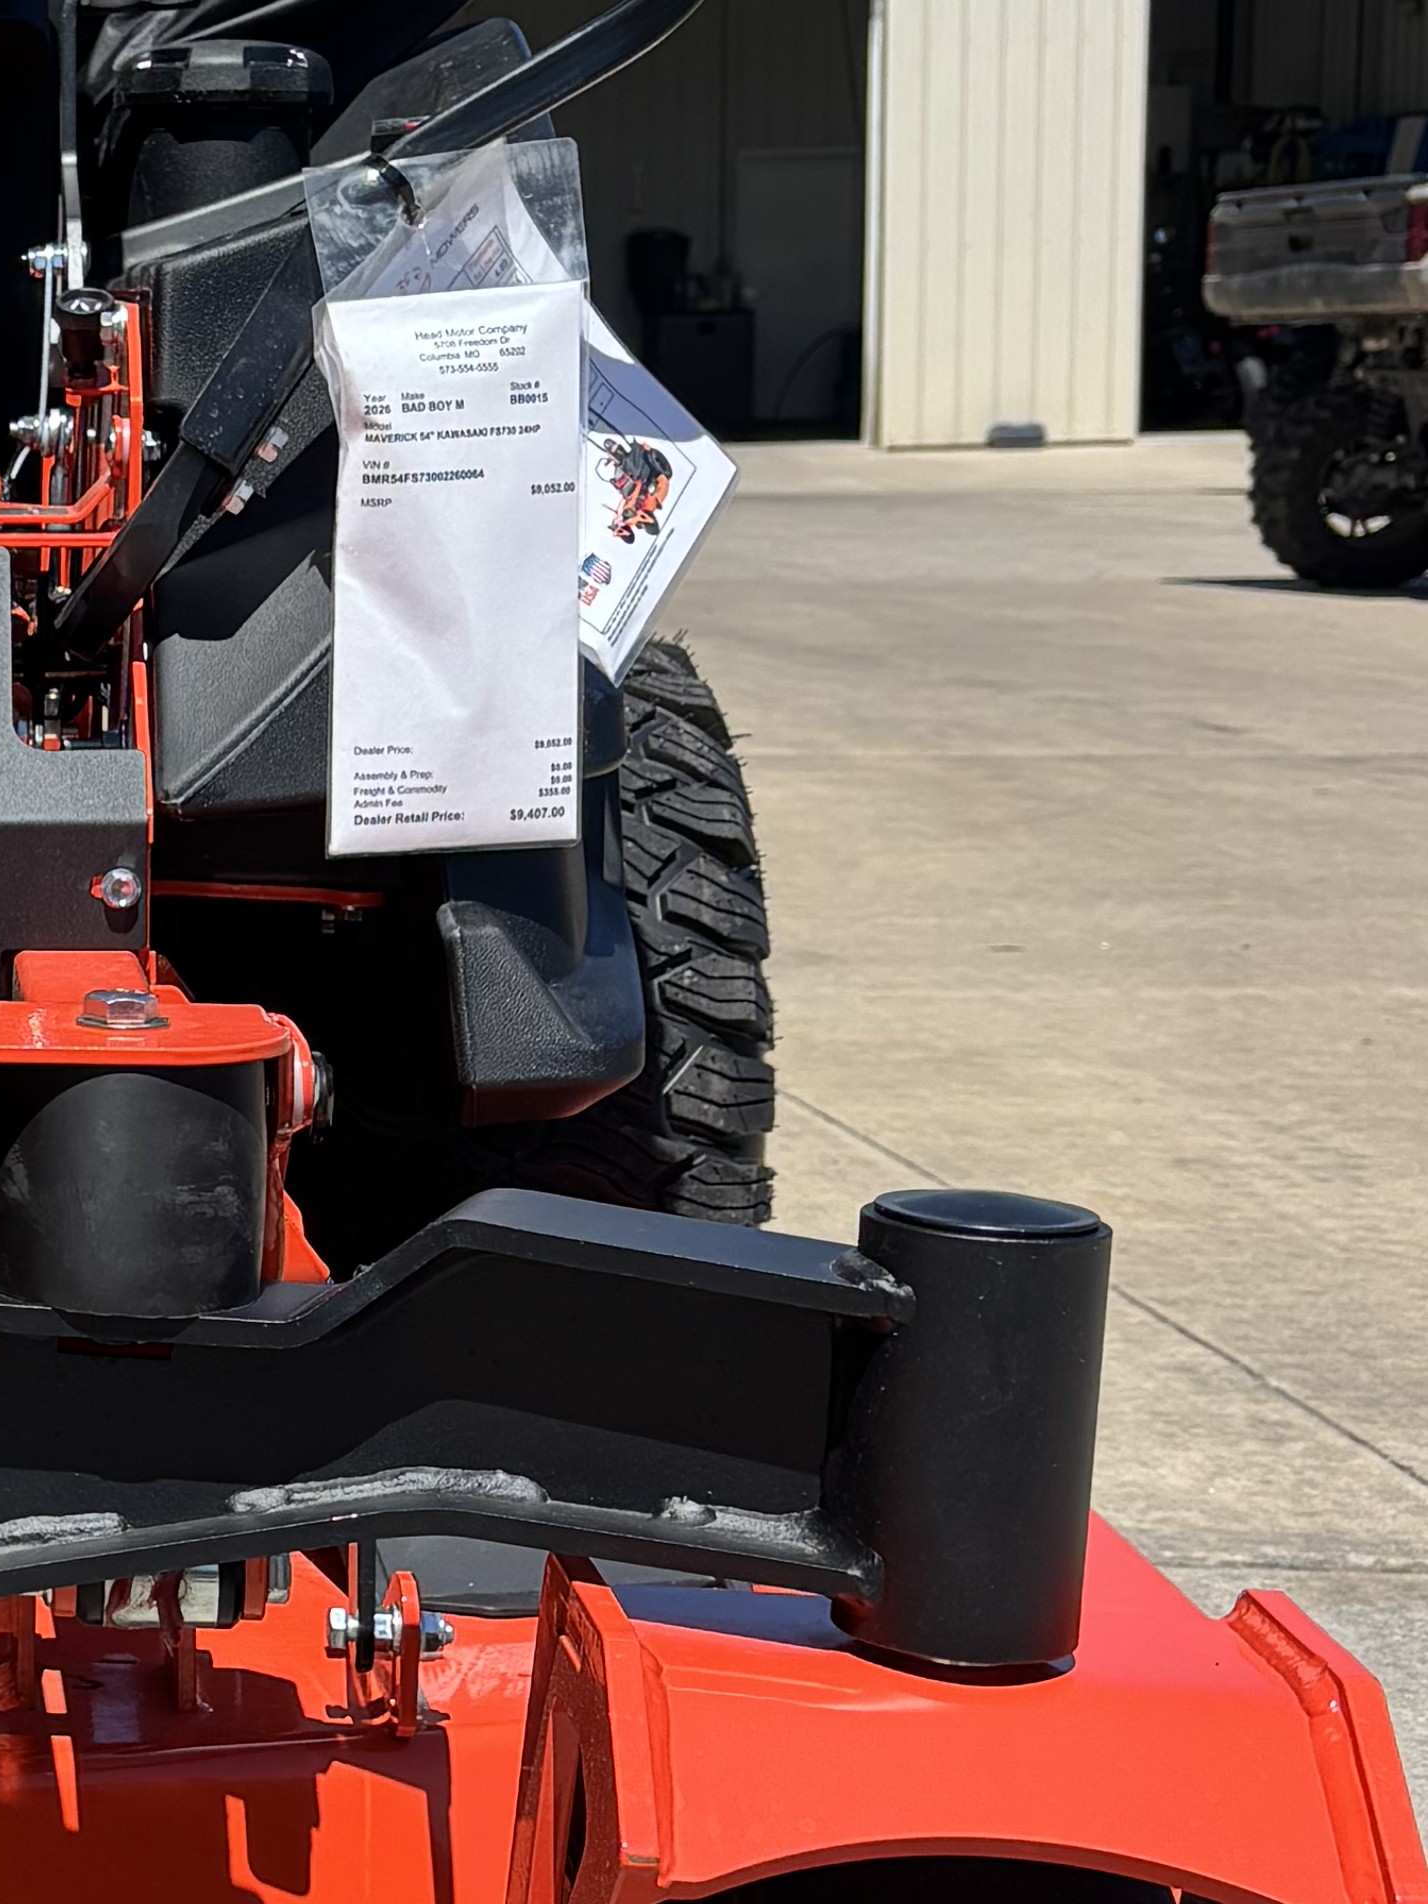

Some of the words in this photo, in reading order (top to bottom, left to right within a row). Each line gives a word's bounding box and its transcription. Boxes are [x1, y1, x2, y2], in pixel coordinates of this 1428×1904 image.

[478, 323, 528, 336] Company
[419, 351, 461, 362] Columbia
[464, 349, 480, 359] MO
[364, 394, 387, 404] Year
[401, 392, 425, 401] Make
[364, 404, 392, 416] 2026
[401, 401, 426, 414] BAD
[428, 400, 453, 413] BOY
[455, 399, 465, 410] M
[363, 421, 392, 432] Model
[364, 430, 419, 444] MAVERICK
[436, 427, 489, 441] KAWASAKI
[362, 460, 382, 470] VIN
[360, 496, 393, 509] MSRP
[353, 745, 385, 756] Dealer
[387, 745, 414, 756] Price:
[353, 770, 399, 782] Assembly
[400, 770, 409, 780] &
[353, 786, 387, 798] Freight
[388, 785, 396, 795] &
[396, 784, 448, 796] Commodity
[353, 799, 384, 809] Admin
[385, 798, 403, 808] Fee
[353, 813, 393, 826] Dealer
[394, 811, 430, 825] Retail
[430, 810, 466, 823] Price:
[509, 805, 566, 822] $9,407.00
